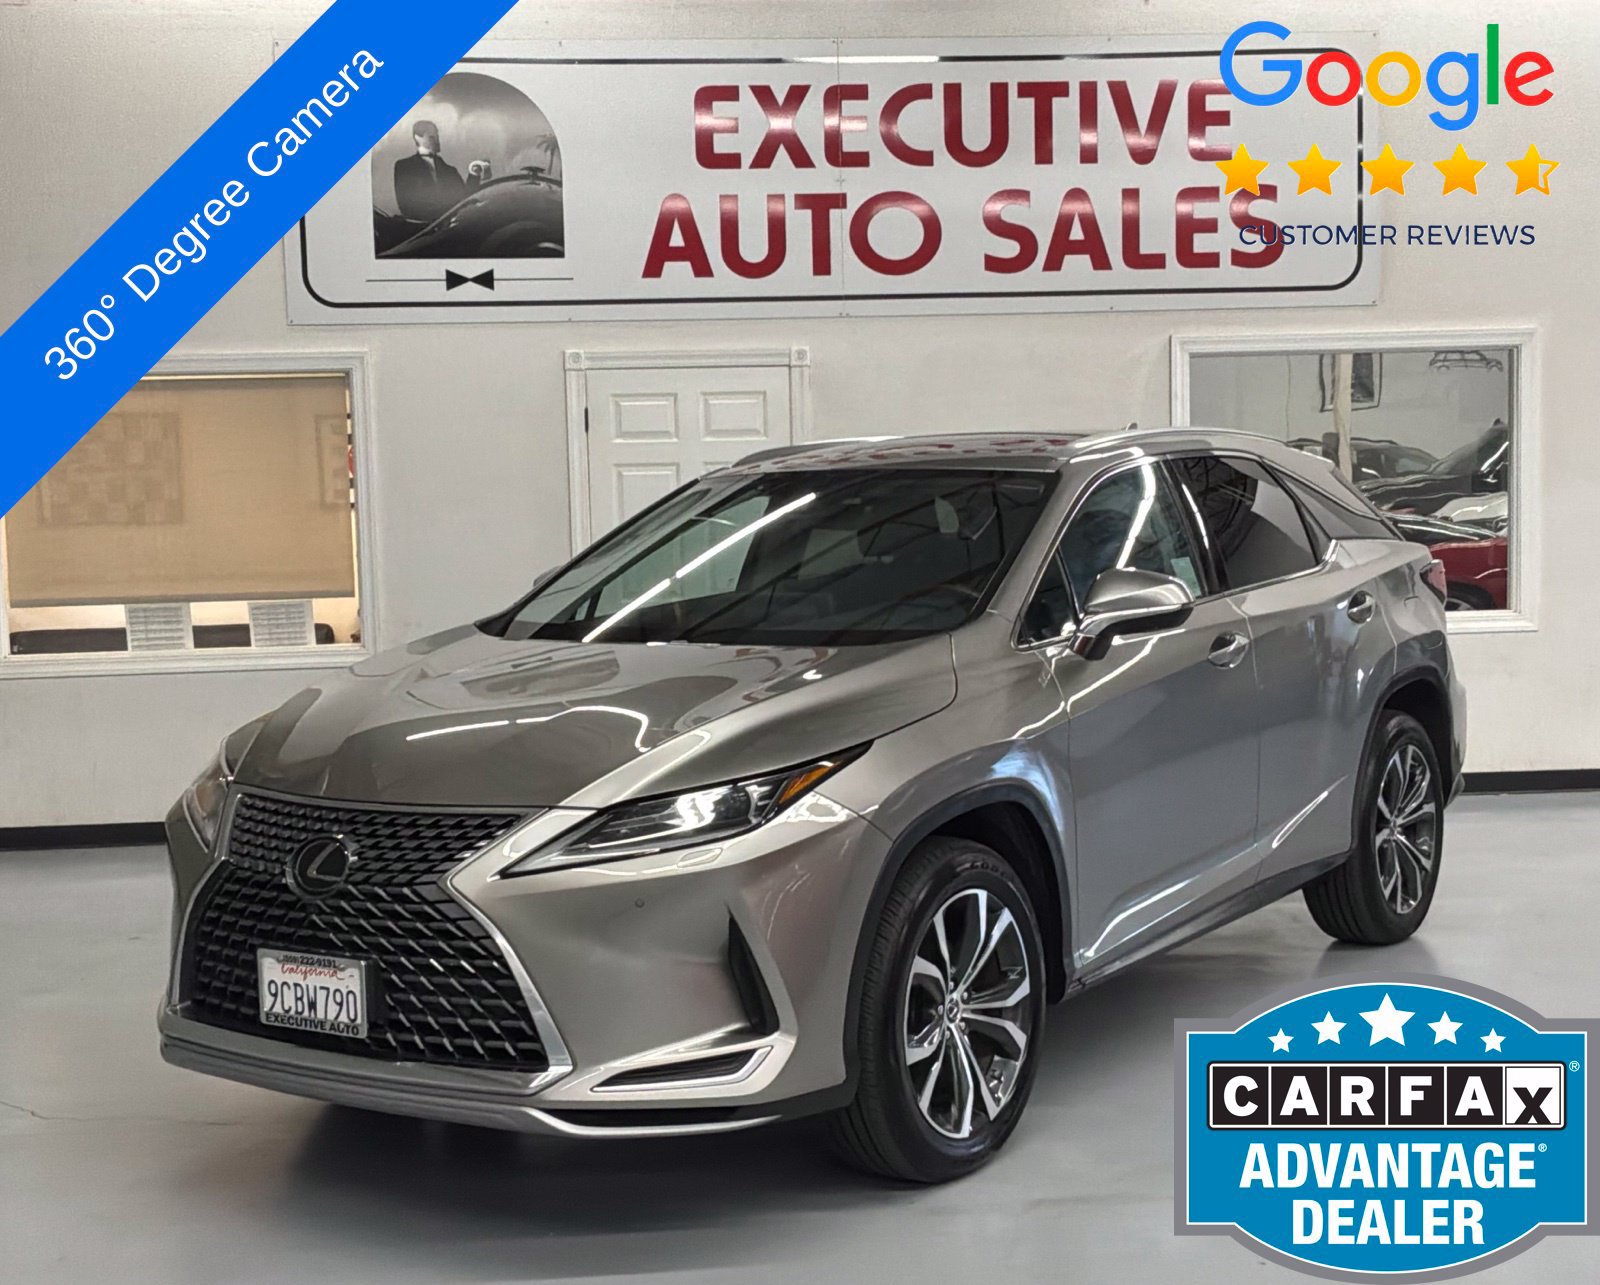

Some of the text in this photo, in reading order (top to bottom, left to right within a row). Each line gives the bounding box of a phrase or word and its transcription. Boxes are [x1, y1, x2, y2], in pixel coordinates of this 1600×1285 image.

[693, 79, 1233, 170] EXECUTIVE
[642, 184, 1285, 279] AUTO SALES
[281, 963, 345, 981] California
[267, 979, 358, 1023] 9CBW790
[265, 1012, 360, 1036] EXECUTIVE AUTO
